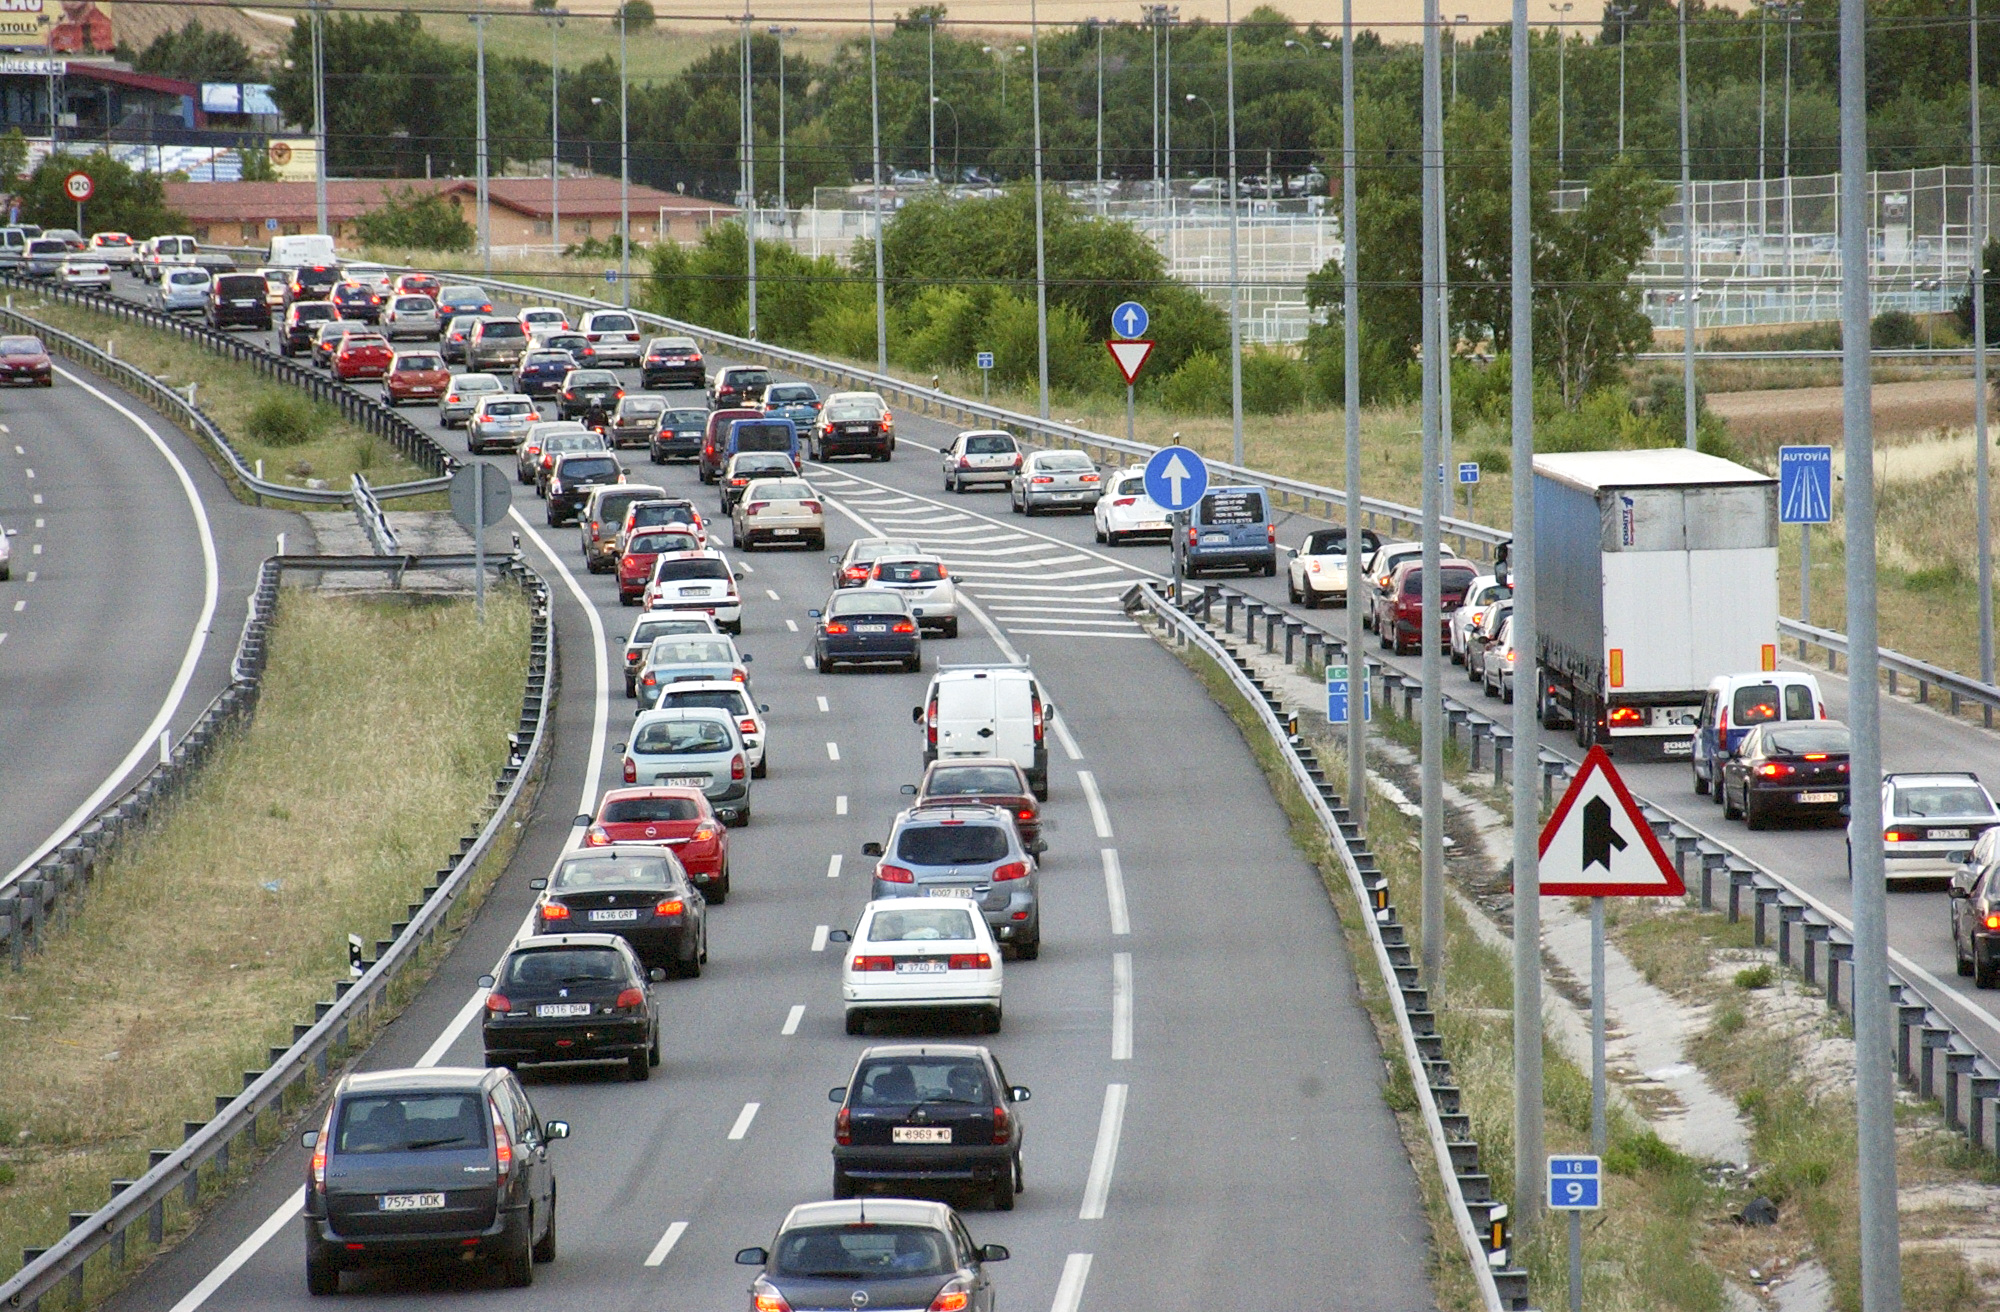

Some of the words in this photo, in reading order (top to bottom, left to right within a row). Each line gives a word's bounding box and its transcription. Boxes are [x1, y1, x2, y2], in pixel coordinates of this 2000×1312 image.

[69, 181, 90, 191] 120
[1566, 1182, 1583, 1203] 9
[386, 1196, 415, 1208] 7575
